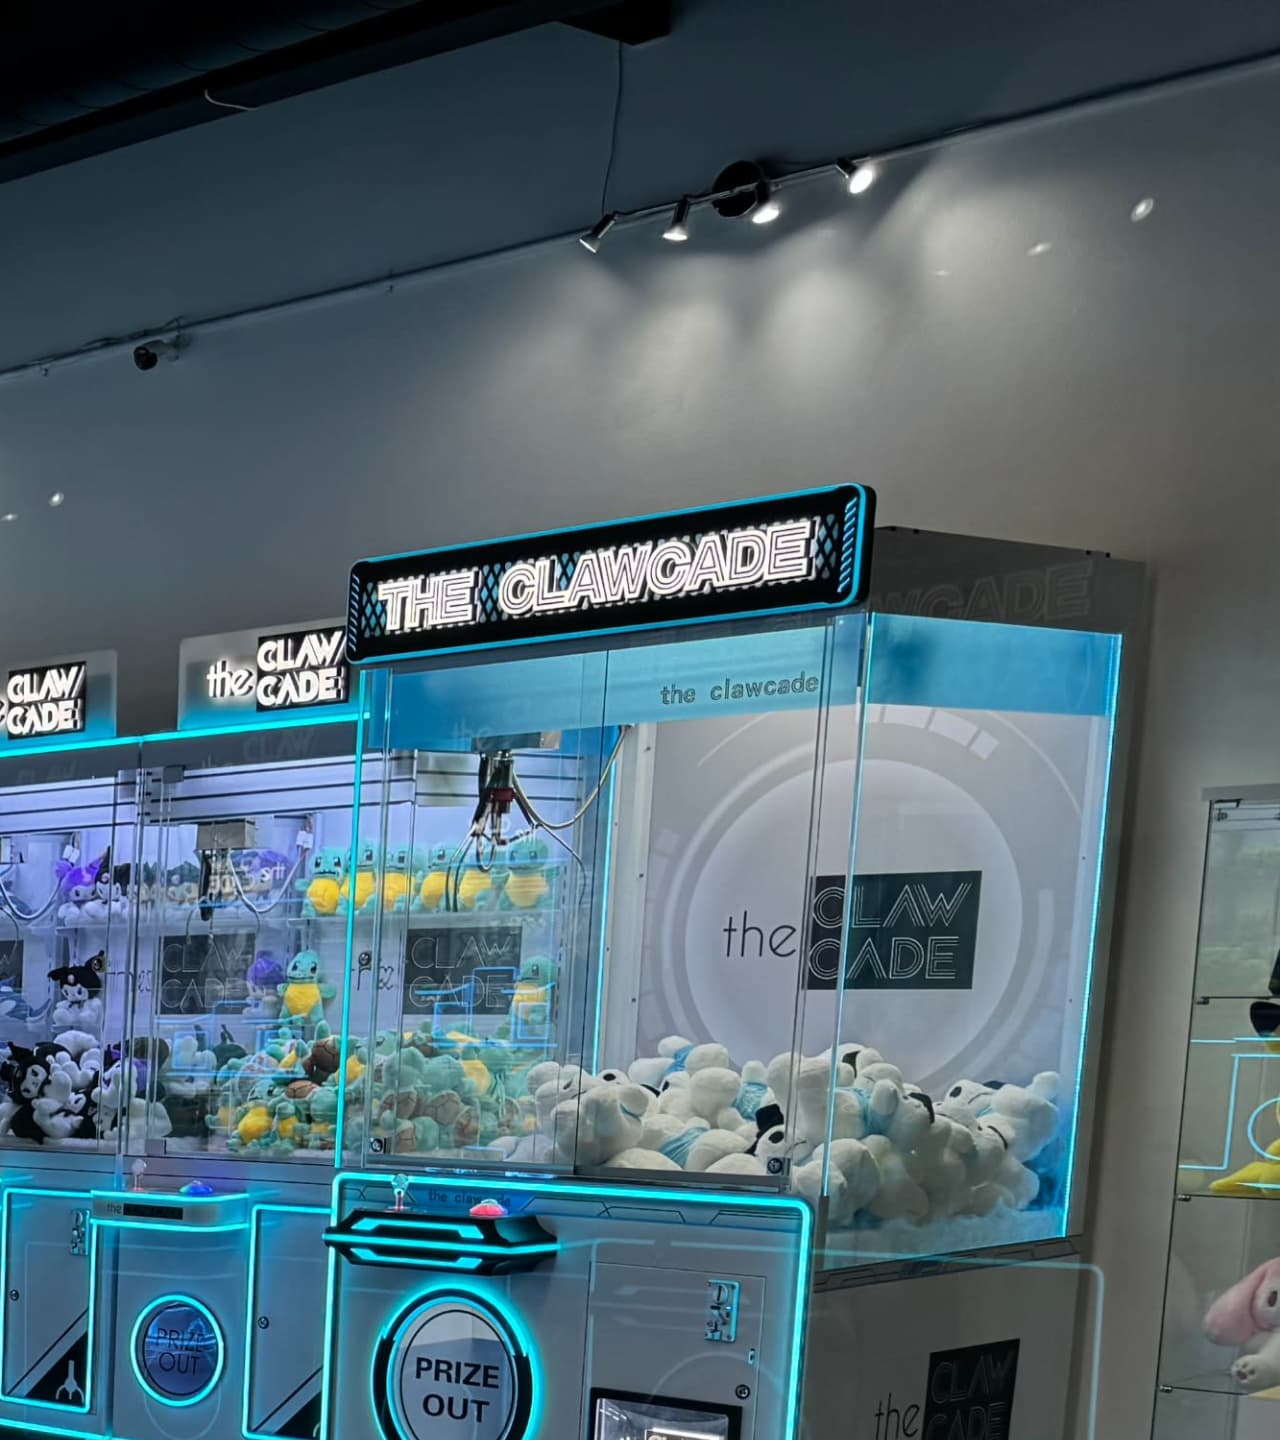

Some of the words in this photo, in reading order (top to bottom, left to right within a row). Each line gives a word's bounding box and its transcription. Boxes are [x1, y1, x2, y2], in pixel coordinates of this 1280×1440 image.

[378, 571, 479, 630] THE
[498, 519, 817, 615] CLAWCADE
[257, 630, 345, 672] CLAW
[7, 665, 85, 699] CLAW
[207, 661, 255, 698] the
[257, 666, 345, 706] CADE
[660, 683, 696, 706] the
[710, 671, 819, 702] clawcade
[7, 698, 82, 735] CADE
[812, 882, 972, 929] CLAW
[723, 910, 797, 958] the
[808, 935, 960, 980] CADE
[155, 1328, 205, 1351] PRIZE
[159, 1352, 200, 1376] OUT
[415, 1356, 500, 1389] PRIZE
[931, 1351, 1017, 1404] CLAW
[422, 1392, 489, 1422] OUT
